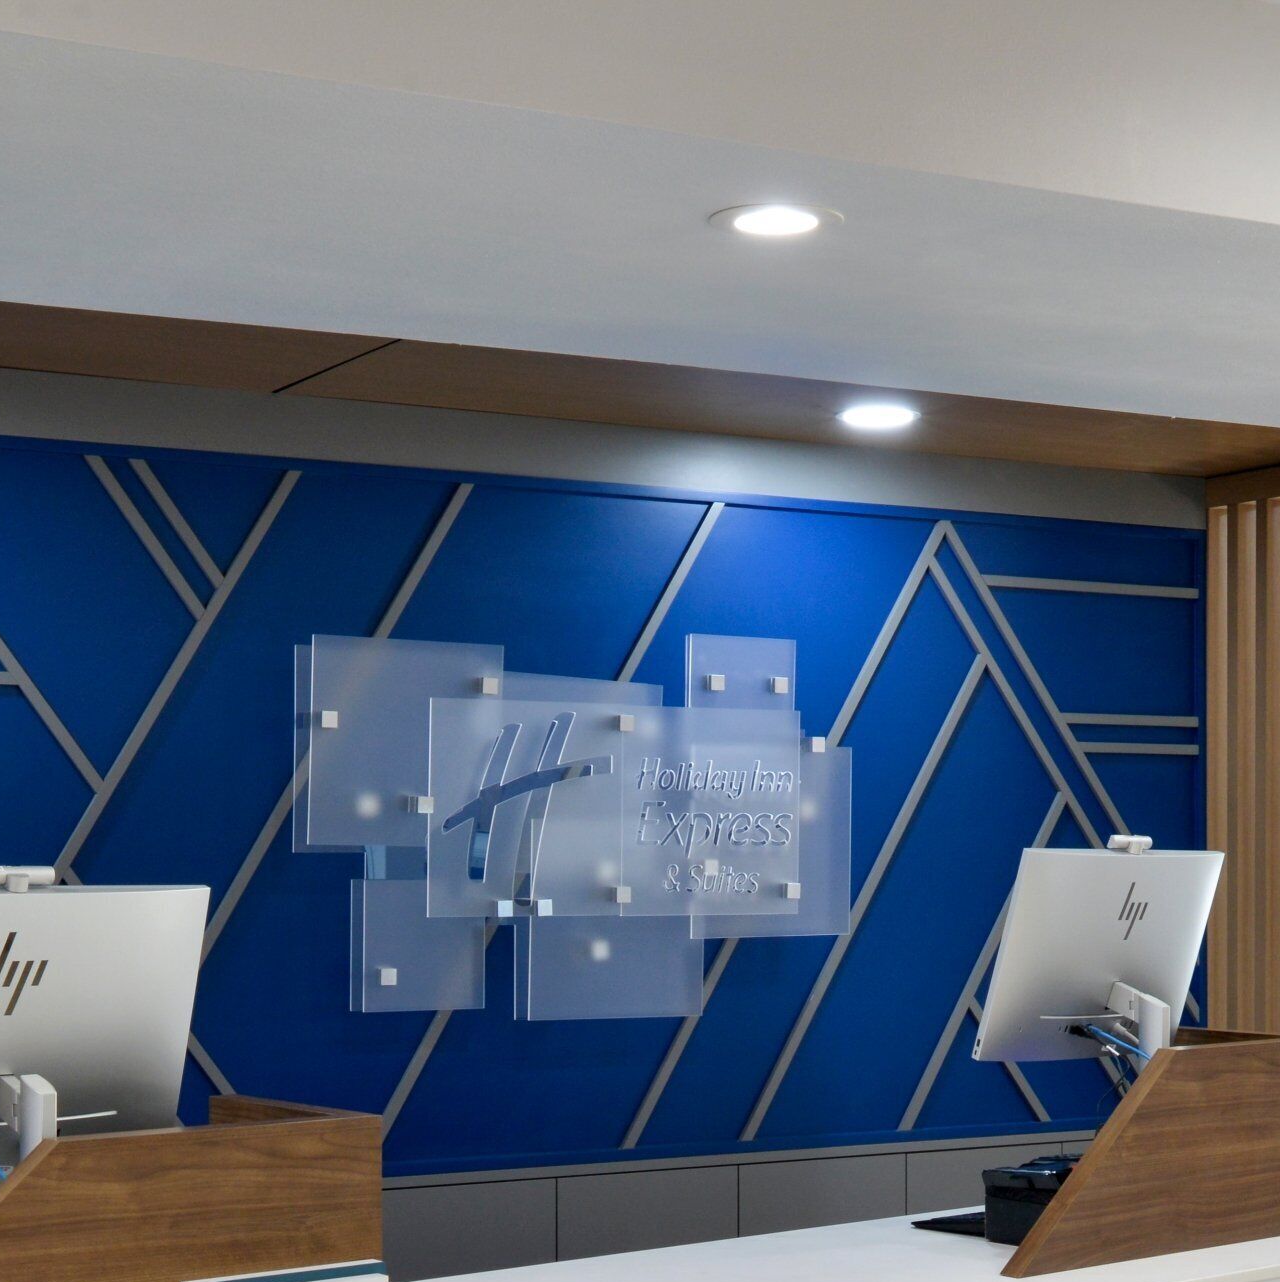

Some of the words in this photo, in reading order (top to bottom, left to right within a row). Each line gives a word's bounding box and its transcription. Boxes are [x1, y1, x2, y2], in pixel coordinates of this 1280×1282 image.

[637, 758, 747, 799] Holiday
[751, 760, 794, 792] Inn
[637, 801, 793, 859] Express
[664, 864, 681, 893] &
[686, 863, 760, 893] Suites
[1117, 882, 1148, 940] hp
